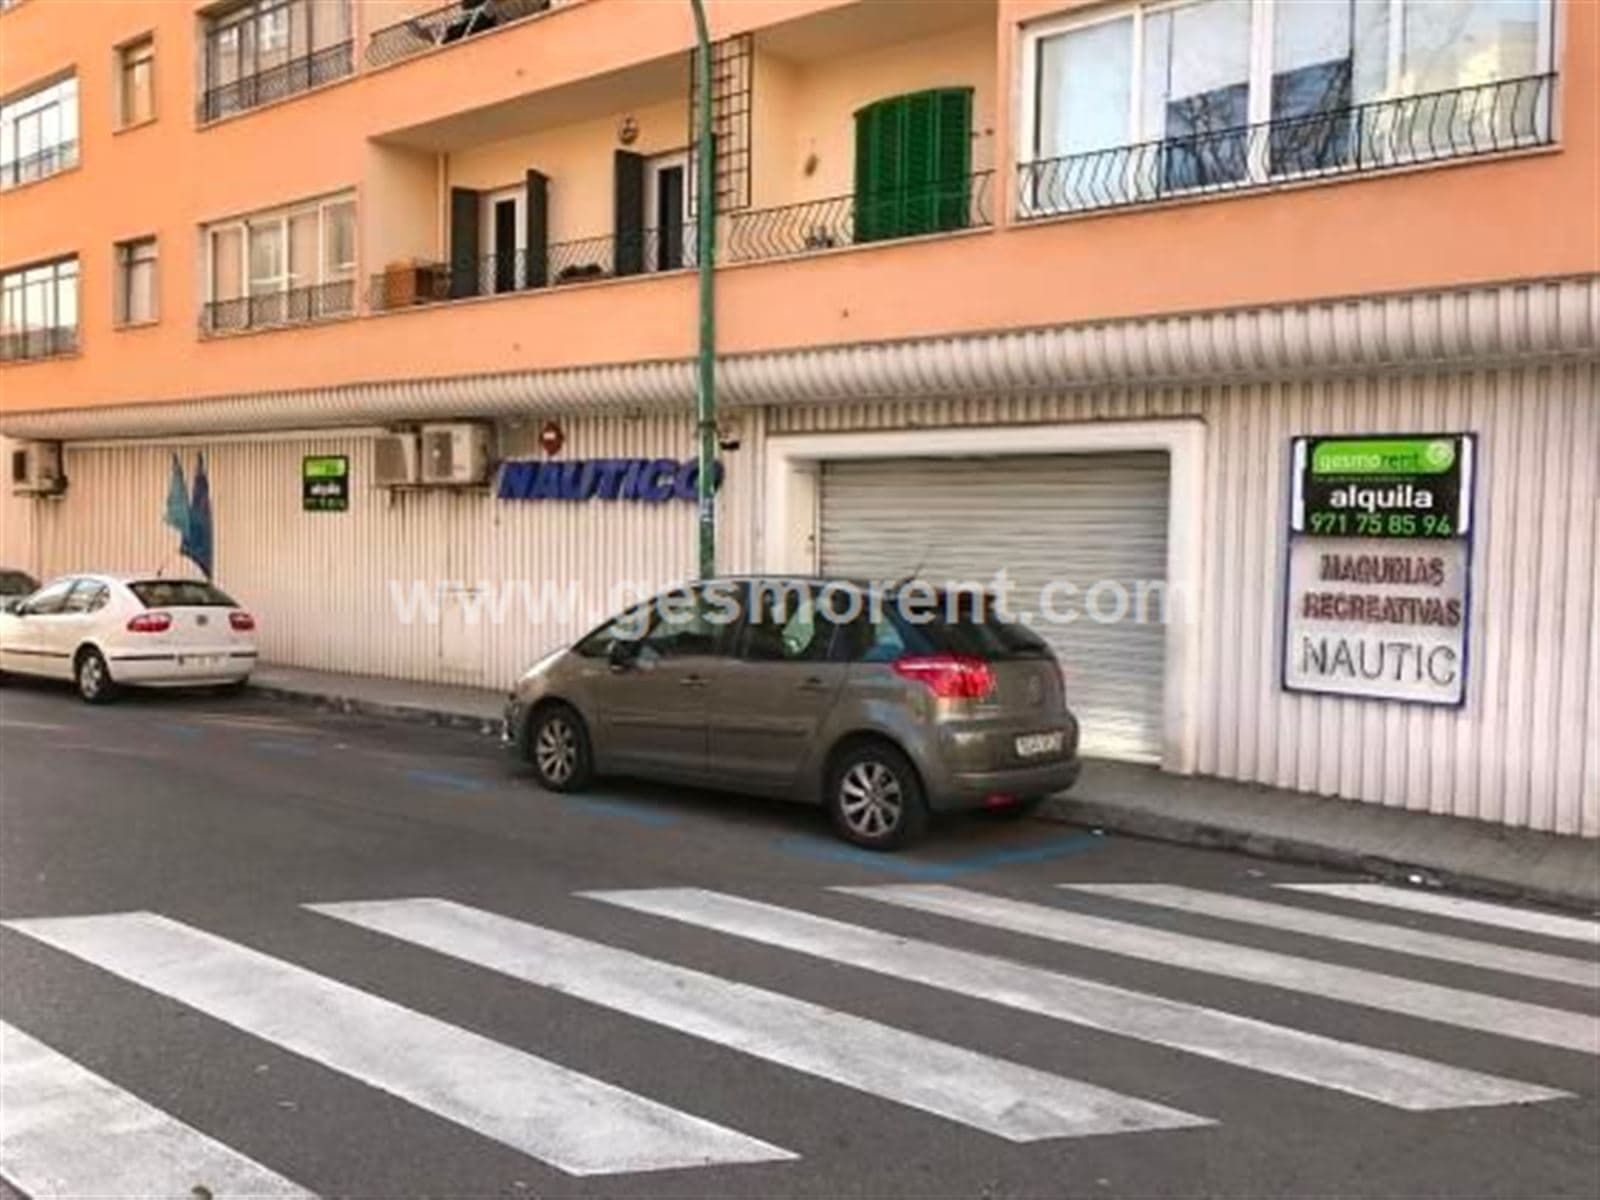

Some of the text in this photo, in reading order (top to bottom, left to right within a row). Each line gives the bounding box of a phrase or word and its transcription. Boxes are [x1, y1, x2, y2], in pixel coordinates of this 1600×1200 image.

[497, 458, 724, 502] NAUTICO
[1329, 484, 1433, 514] alquila
[1310, 512, 1452, 536] 971 75 85 94
[1302, 591, 1461, 628] RECREATIVAS
[1301, 635, 1456, 687] NAUTIC
